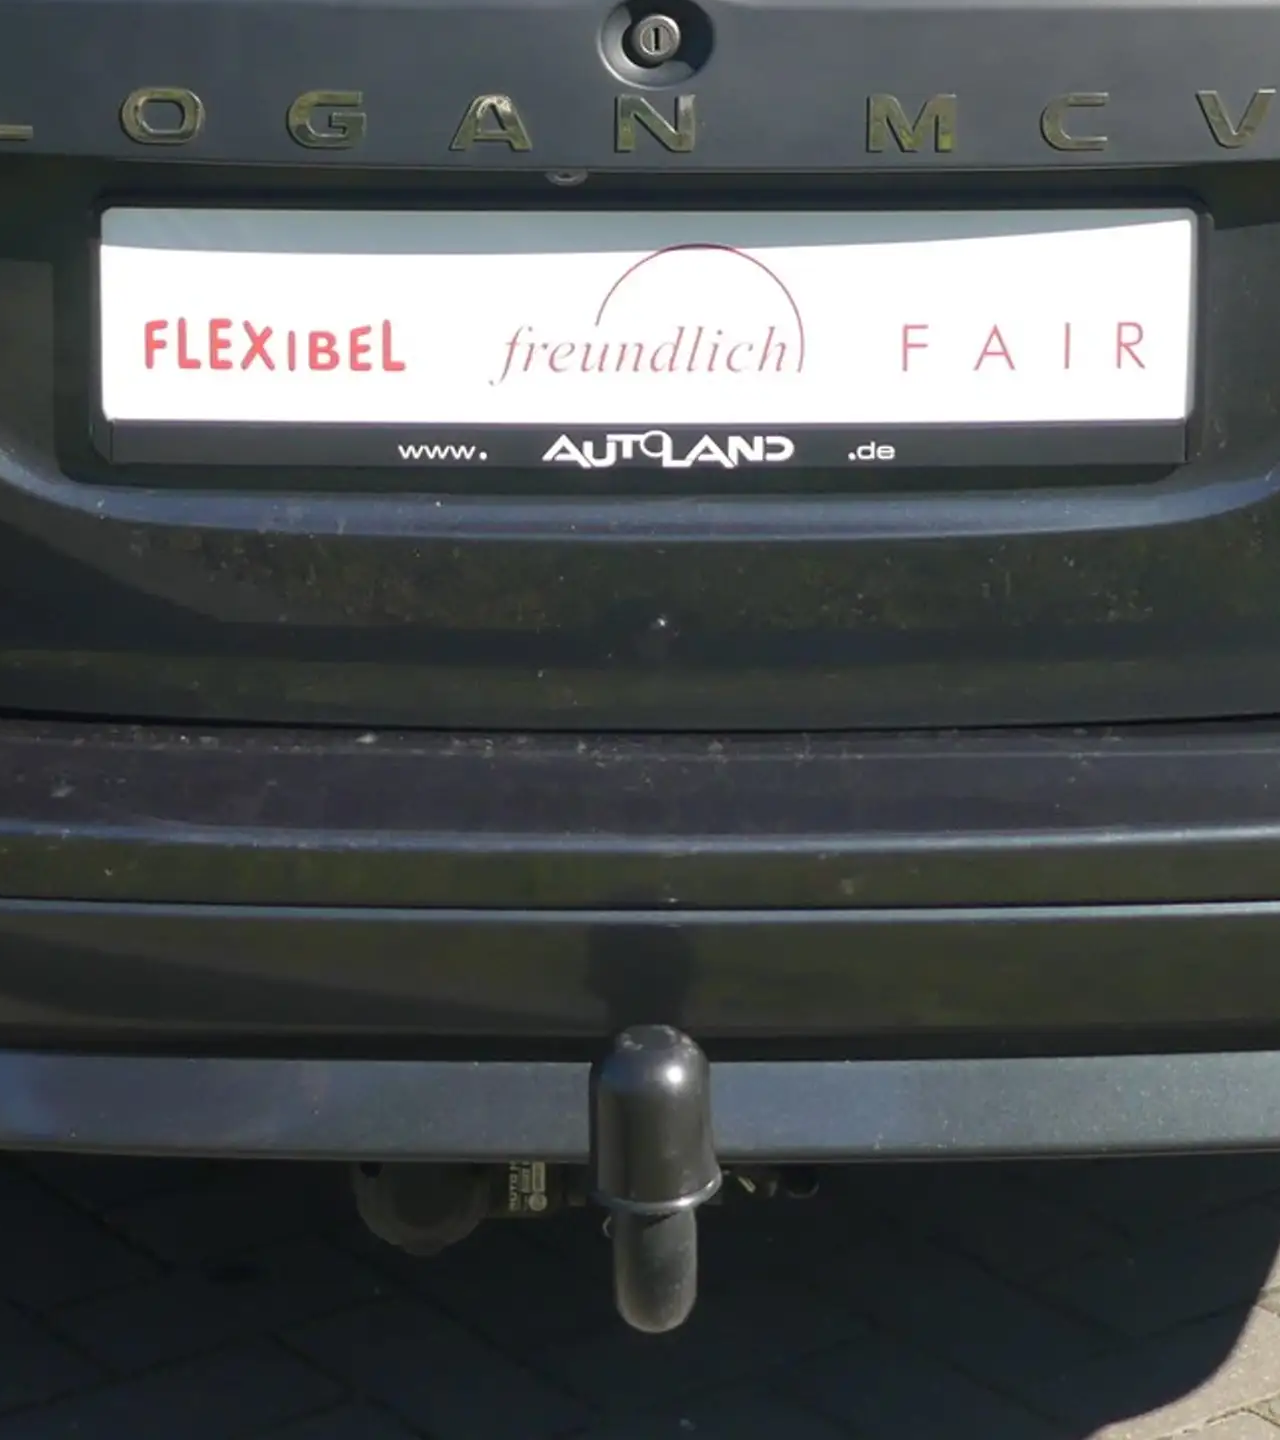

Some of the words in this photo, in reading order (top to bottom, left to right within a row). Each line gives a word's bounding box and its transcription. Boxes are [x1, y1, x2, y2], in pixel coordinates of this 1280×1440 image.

[866, 87, 1277, 153] MCV
[144, 317, 406, 372] FLEXIBEL
[488, 325, 786, 386] freundlich
[901, 321, 1147, 372] FAIR
[542, 429, 795, 470] AUTOLAND
